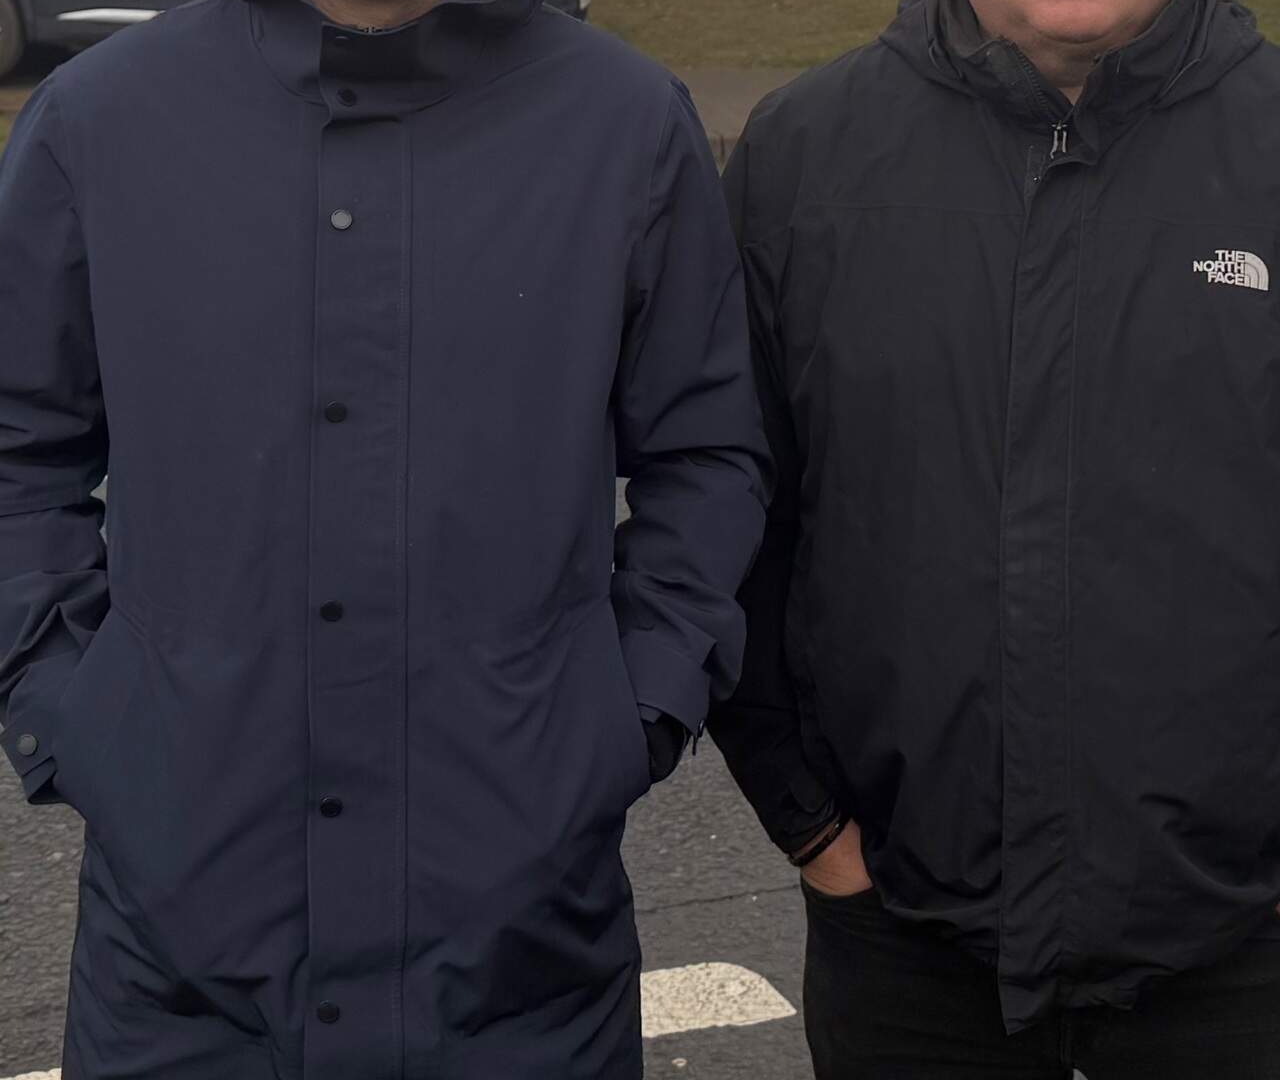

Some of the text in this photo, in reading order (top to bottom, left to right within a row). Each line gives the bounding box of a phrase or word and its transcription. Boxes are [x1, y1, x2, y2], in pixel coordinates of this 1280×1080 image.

[1215, 249, 1246, 262] THE
[1193, 259, 1244, 274] NORTH
[1207, 271, 1245, 287] FACE
